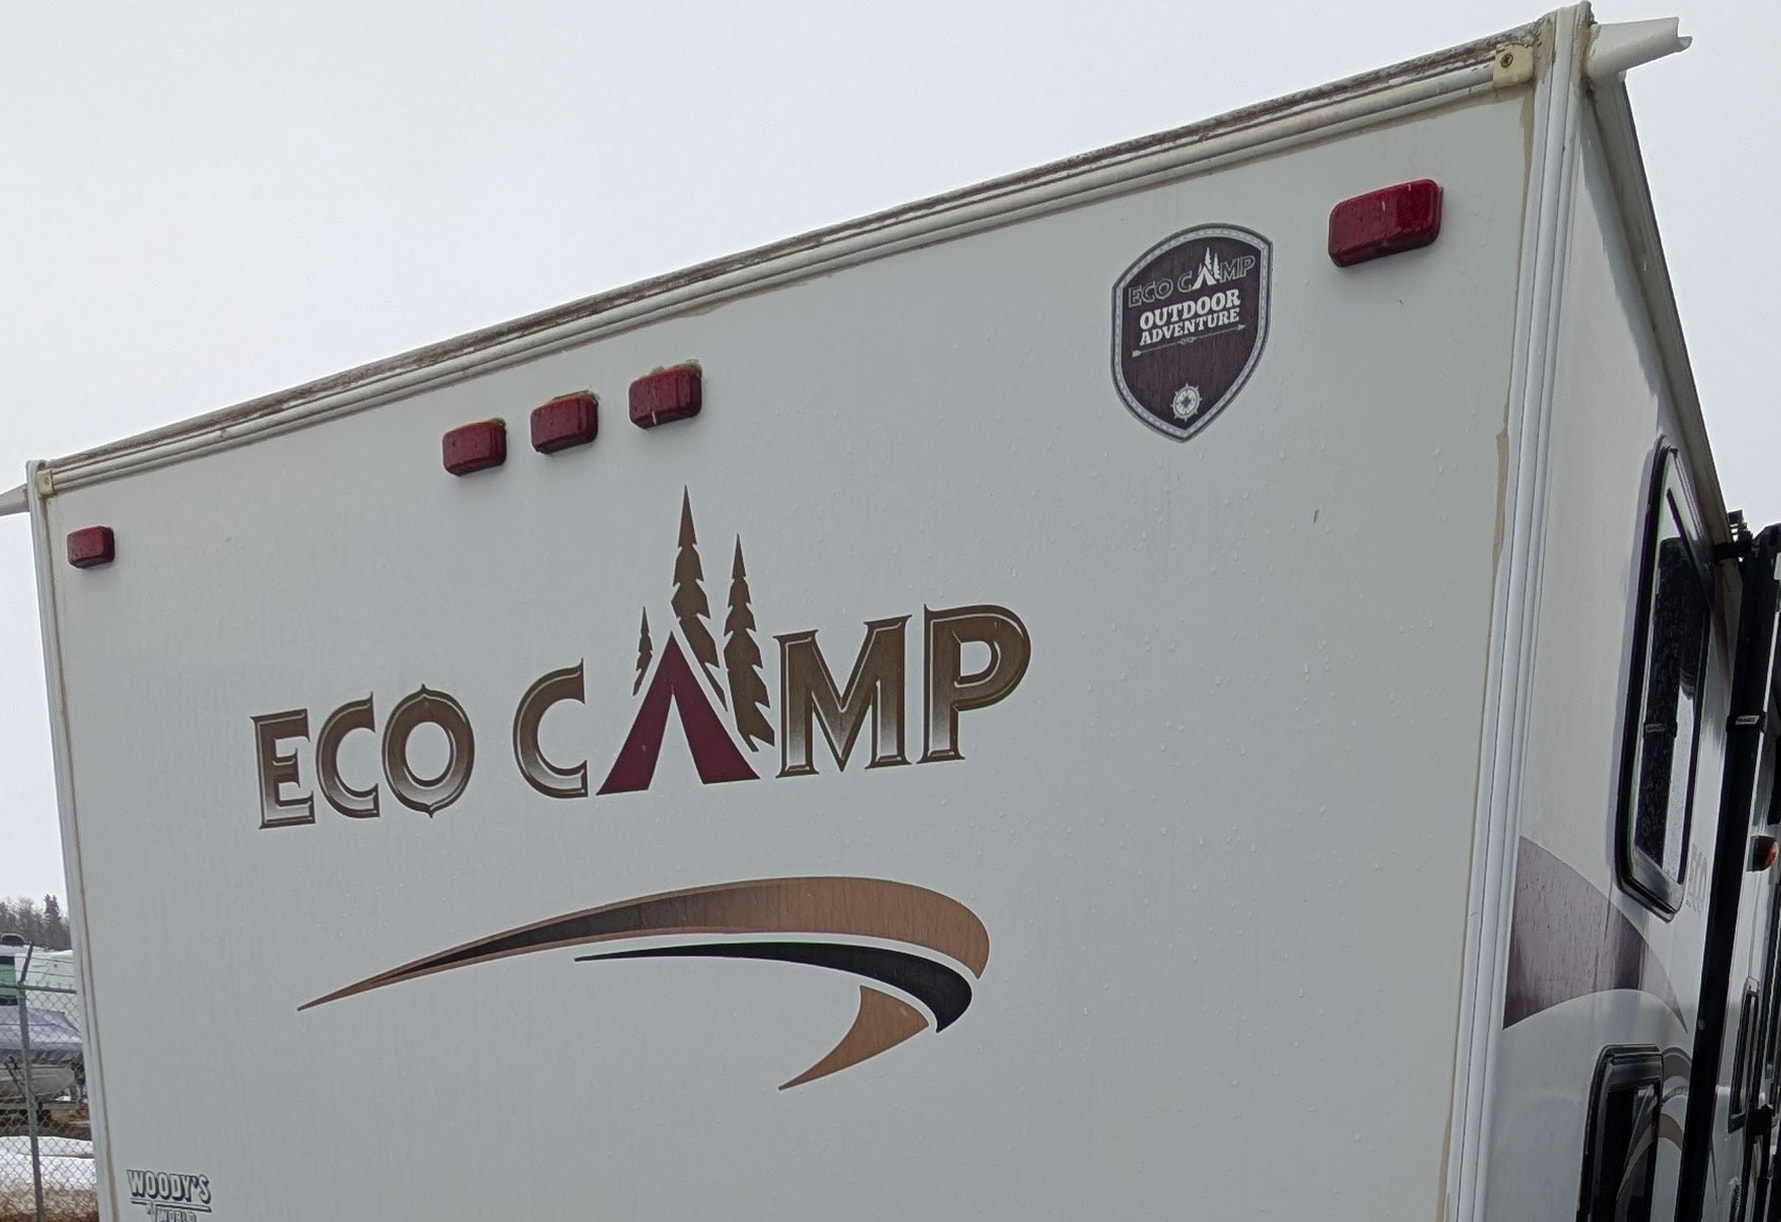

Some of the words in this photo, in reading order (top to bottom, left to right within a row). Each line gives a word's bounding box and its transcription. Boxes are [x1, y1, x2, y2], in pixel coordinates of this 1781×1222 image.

[1128, 278, 1174, 307] ECO
[1140, 289, 1241, 330] OUTDOOR
[1139, 308, 1240, 346] ADVENTURE
[250, 683, 476, 830] ECO
[513, 603, 1032, 800] CAMP
[126, 1169, 212, 1204] WOODY'S
